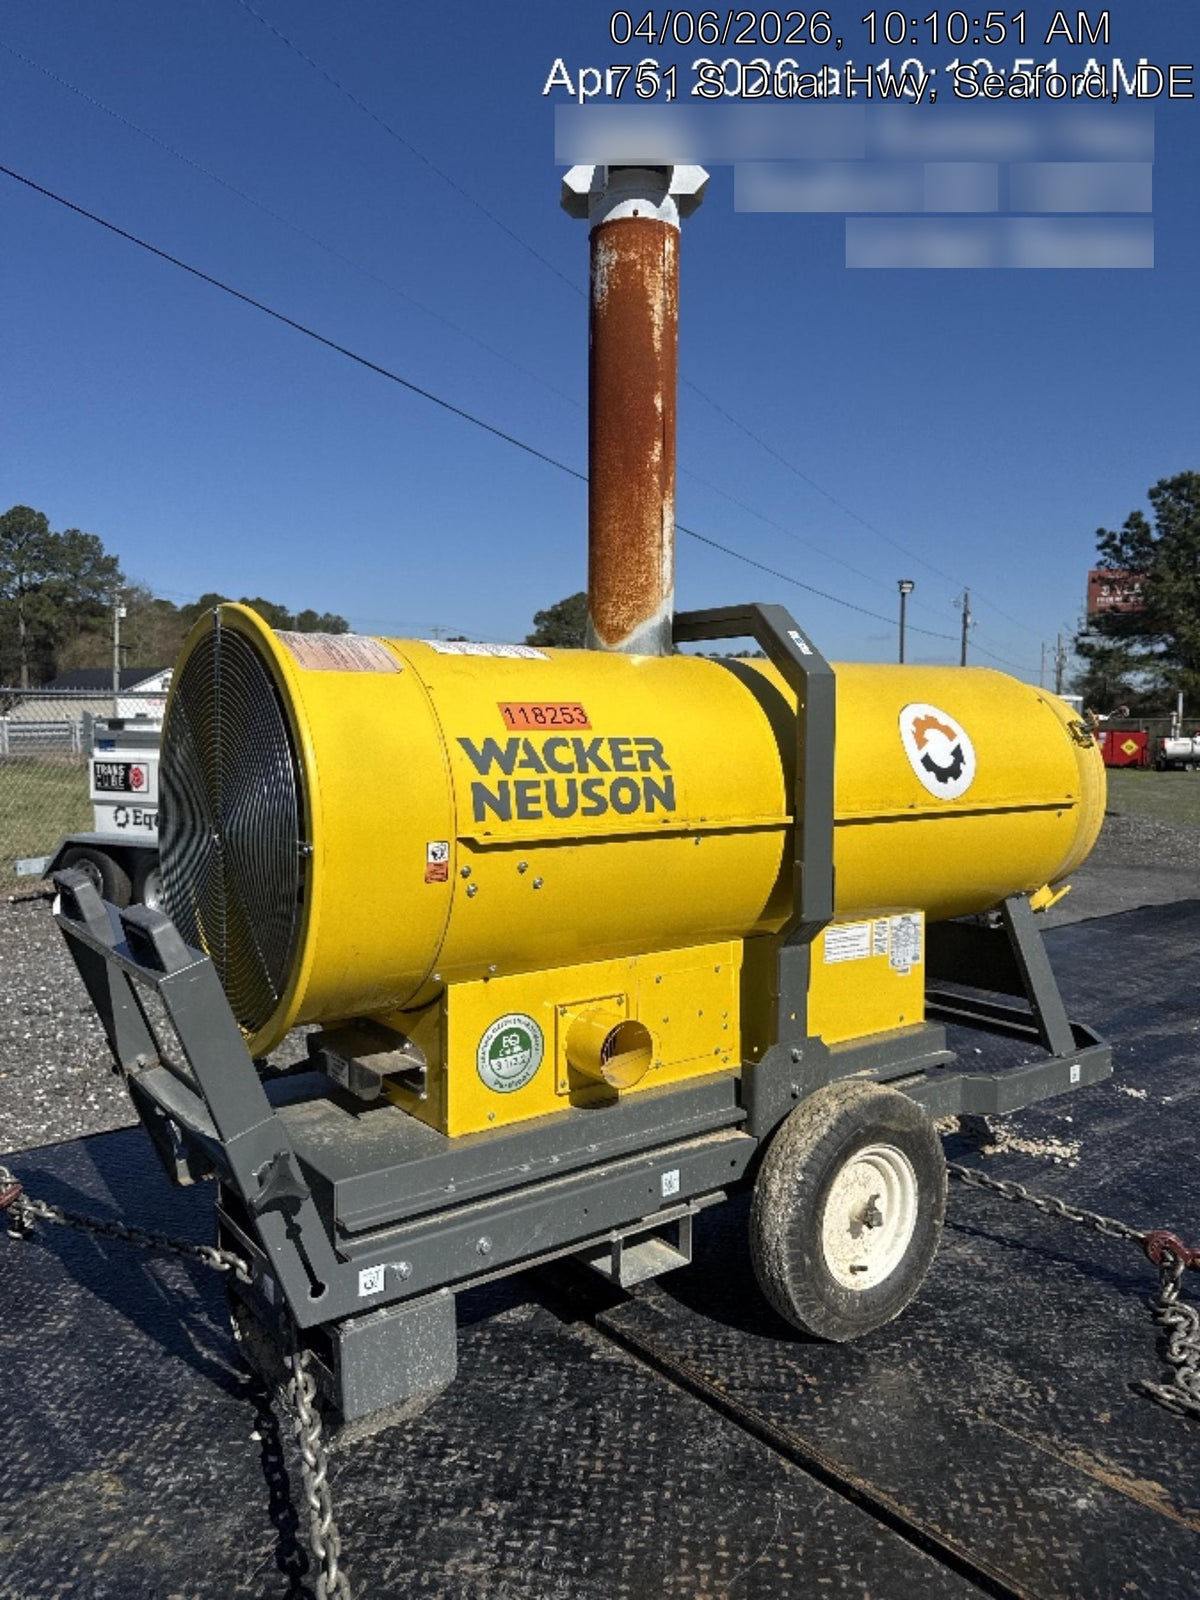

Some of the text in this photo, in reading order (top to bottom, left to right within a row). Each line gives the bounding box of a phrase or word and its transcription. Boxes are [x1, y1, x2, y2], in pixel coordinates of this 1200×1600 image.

[504, 706, 588, 726] 118253
[456, 736, 671, 776] WACKER
[470, 775, 677, 823] NEUSON
